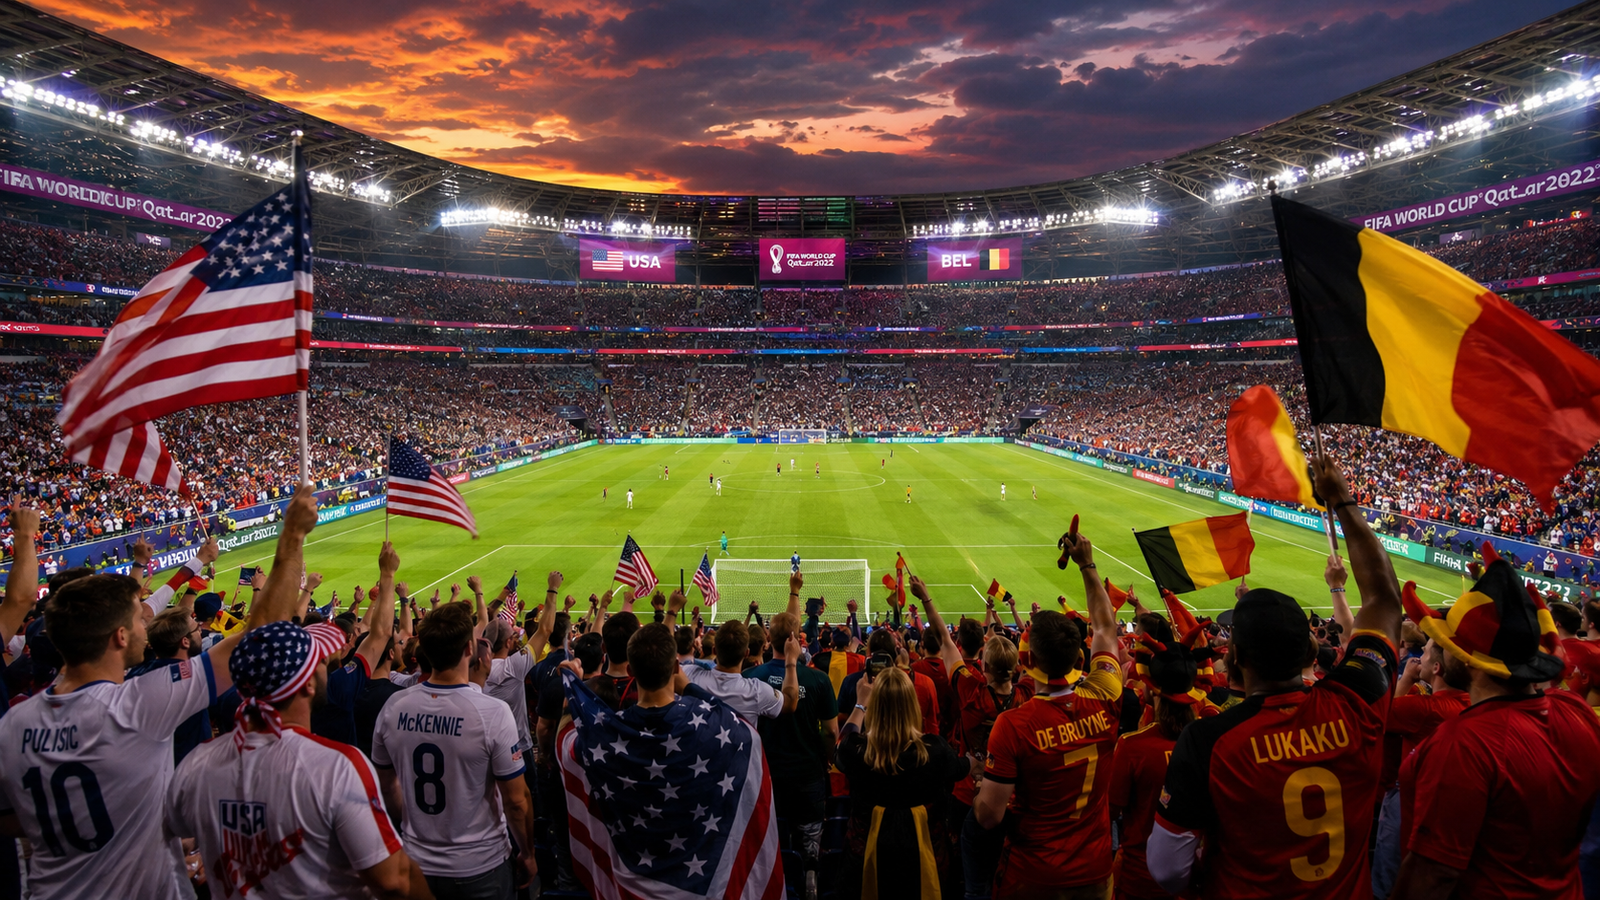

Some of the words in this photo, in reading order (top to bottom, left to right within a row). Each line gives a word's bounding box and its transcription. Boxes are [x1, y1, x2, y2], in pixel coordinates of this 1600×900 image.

[1364, 215, 1392, 230] FIFA
[1394, 203, 1445, 225] WORLD
[629, 255, 661, 268] USA
[941, 254, 972, 268] BEL
[21, 725, 79, 754] PULISIC
[397, 712, 464, 737] McKENNIE
[1035, 727, 1058, 751] DE
[1058, 710, 1111, 745] BRUYNE
[1250, 719, 1350, 764] LUKAKU
[412, 742, 447, 815] 8
[1063, 743, 1099, 820] 7
[22, 761, 115, 858] 10
[221, 803, 265, 836] USA
[1282, 766, 1346, 882] 9
